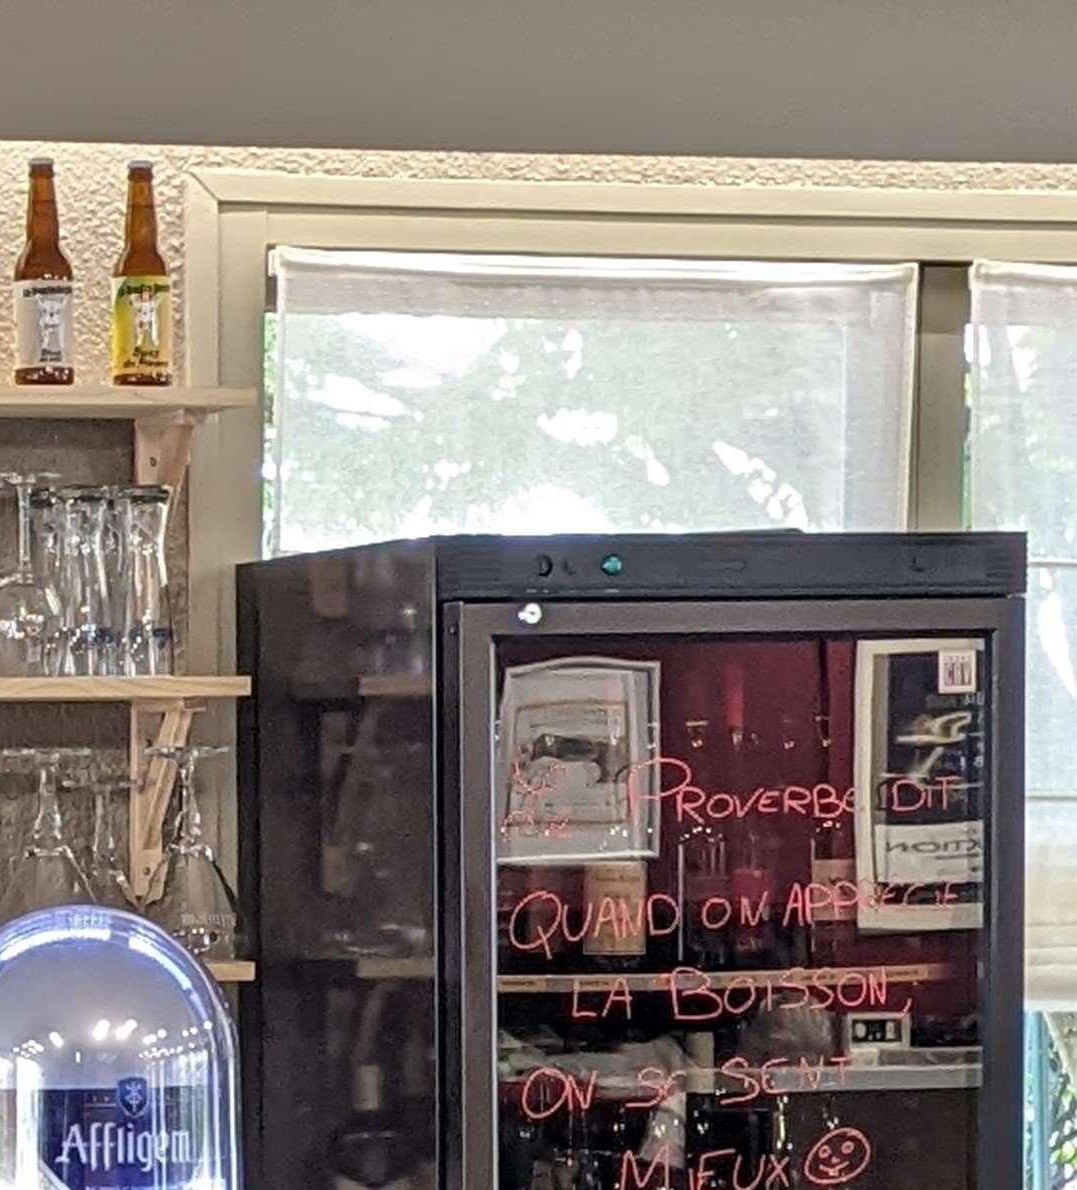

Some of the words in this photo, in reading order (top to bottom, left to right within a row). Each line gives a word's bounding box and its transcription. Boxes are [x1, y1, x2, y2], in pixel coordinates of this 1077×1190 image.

[891, 775, 962, 812] DIT
[508, 890, 680, 960] QUAND
[701, 890, 770, 932] ON
[571, 977, 633, 1020] LA
[521, 1066, 598, 1120] ON
[54, 1121, 191, 1173] Affligem
